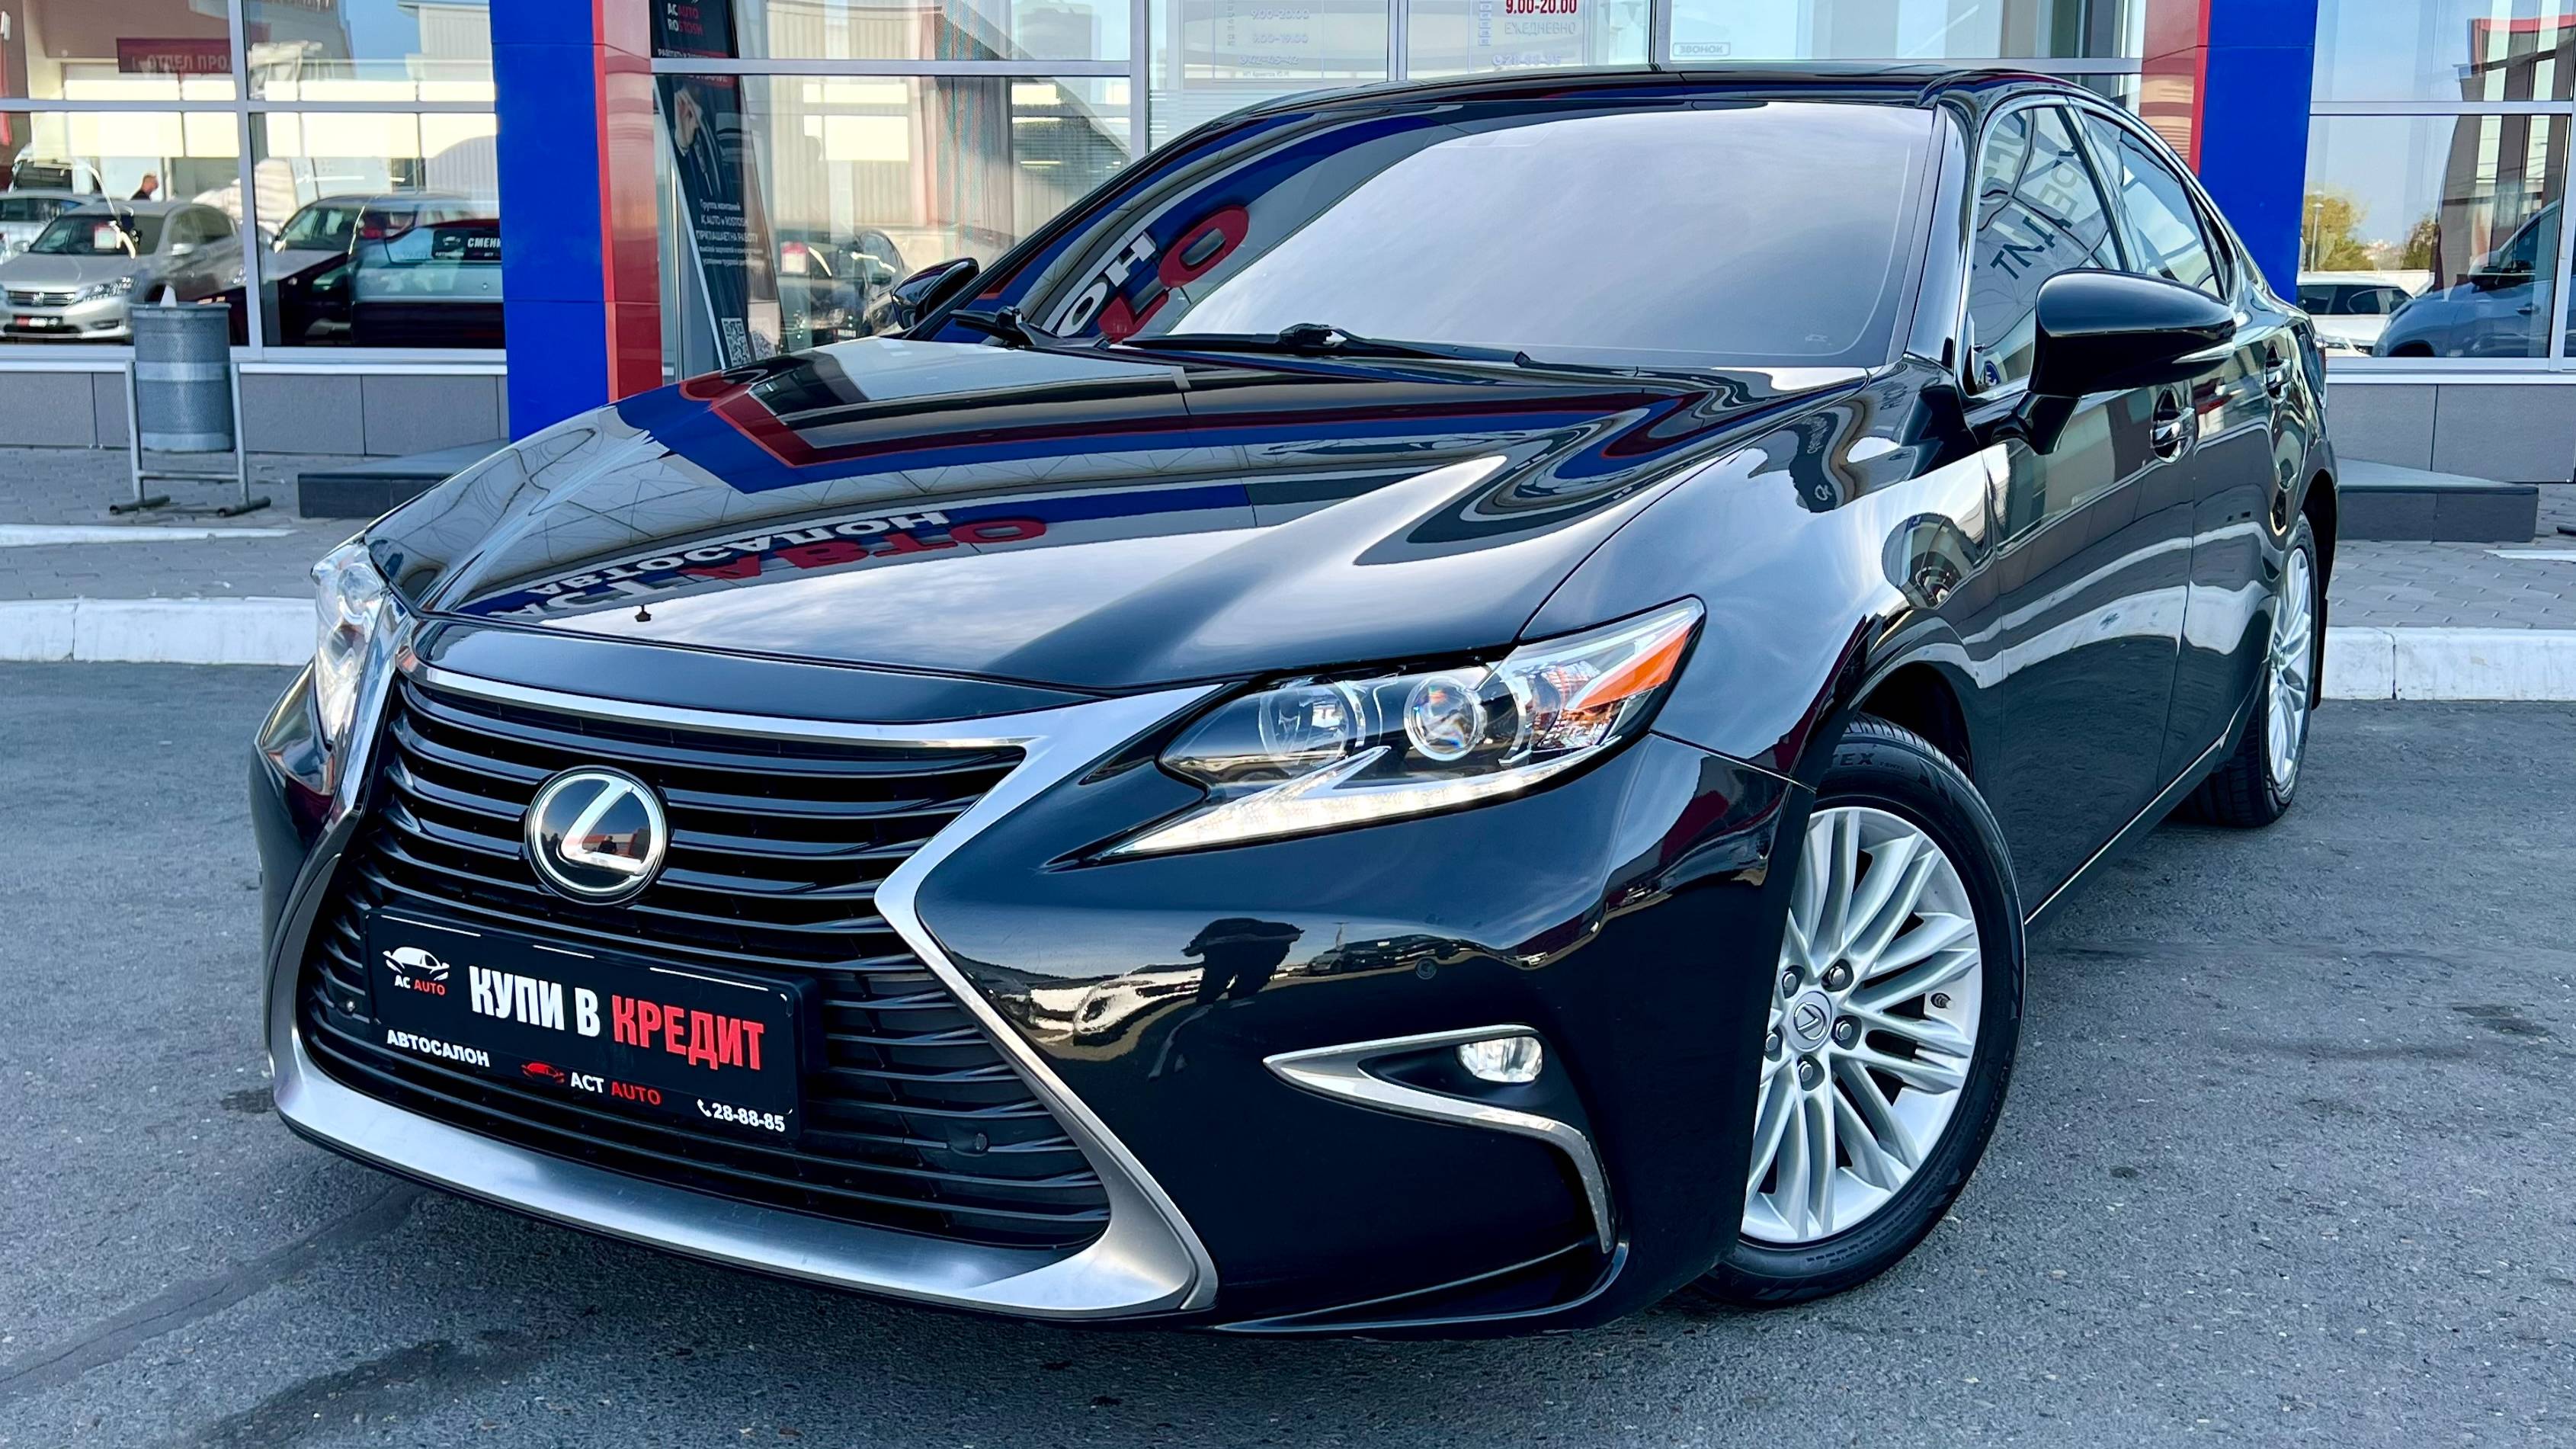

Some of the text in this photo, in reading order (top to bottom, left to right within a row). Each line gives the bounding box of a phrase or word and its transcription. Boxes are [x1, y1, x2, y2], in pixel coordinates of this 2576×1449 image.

[1506, 0, 1576, 14] 9.00-20.00
[1504, 21, 1576, 36] ЕЖЕДНЕВНО
[1680, 45, 1723, 54] ЗВОНОК
[197, 54, 232, 71] ПРО
[413, 978, 445, 996] AUTO
[469, 965, 764, 1071] КУПИ В КРЕДИТ
[386, 1029, 491, 1068] АВТОСАЛОН
[610, 1081, 662, 1106] AUTO
[711, 1102, 786, 1133] 28-88-85
